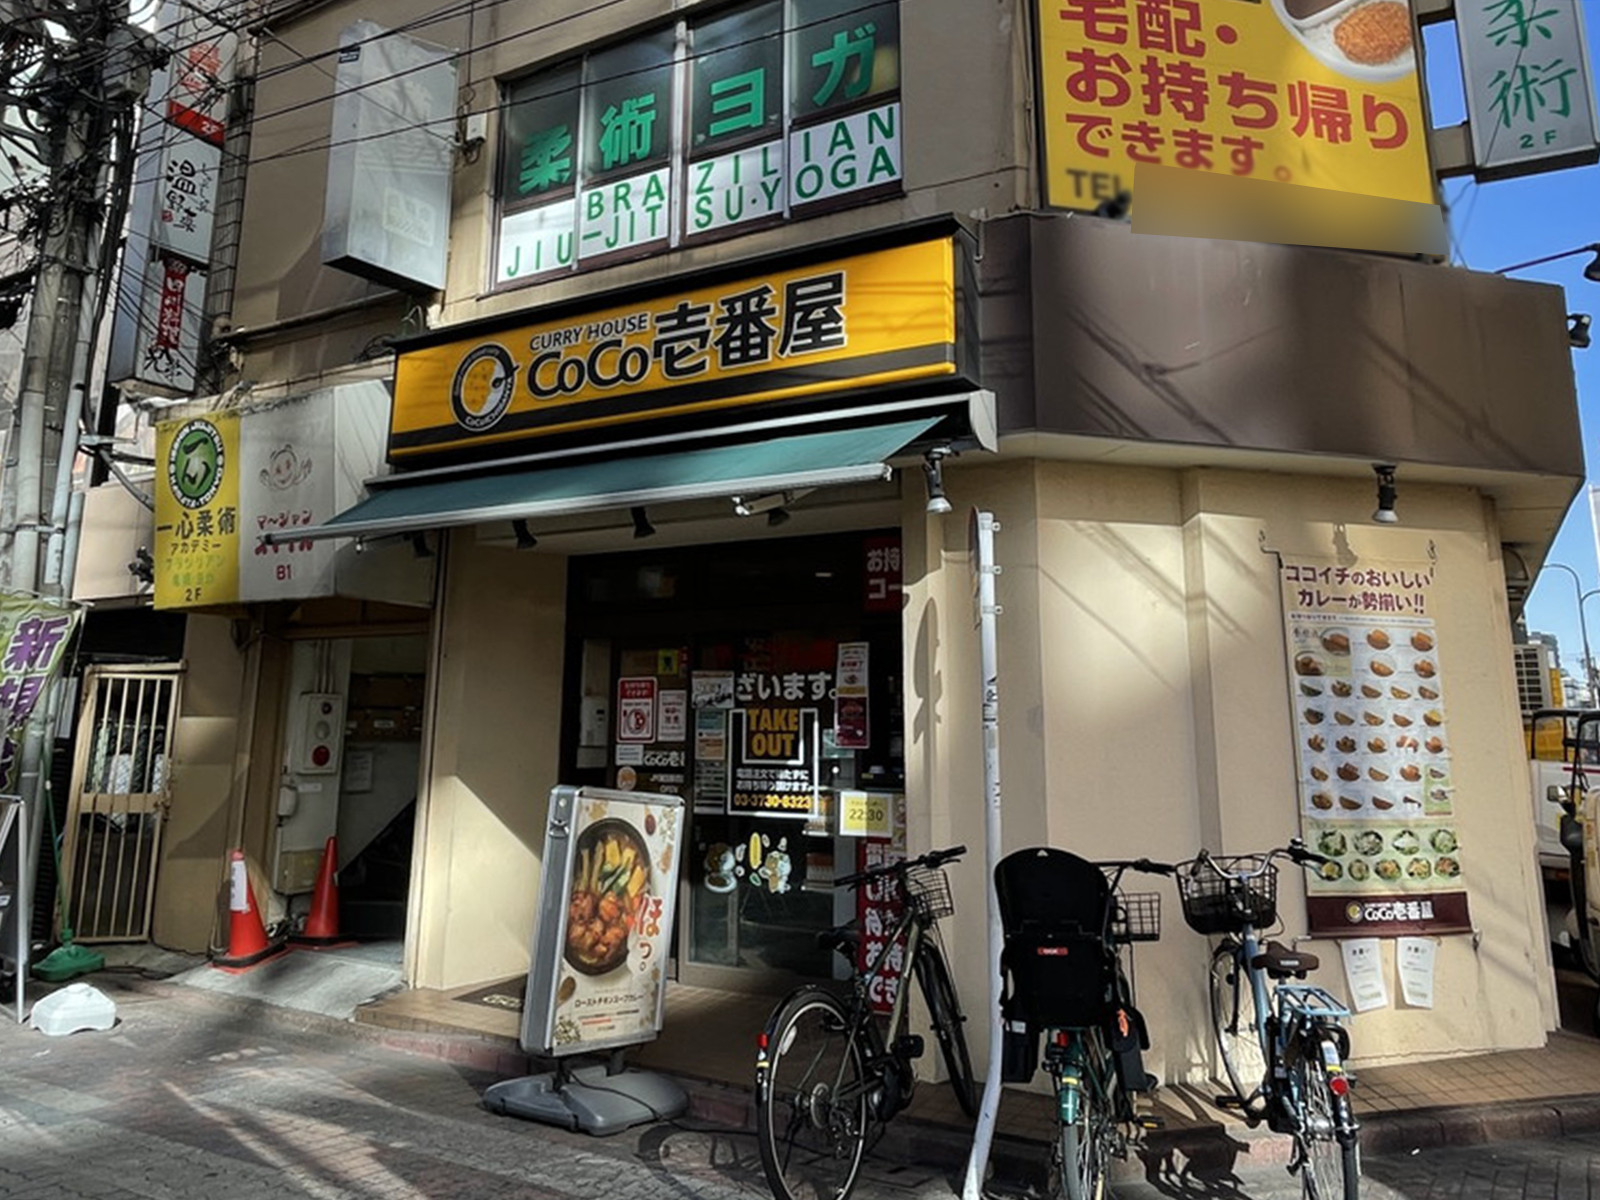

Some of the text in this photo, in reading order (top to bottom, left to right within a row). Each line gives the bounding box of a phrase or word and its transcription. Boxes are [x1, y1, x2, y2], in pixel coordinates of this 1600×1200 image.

[1482, 0, 1577, 129] 柔術
[1066, 47, 1409, 150] お持ち帰り
[1065, 113, 1292, 183] できます。
[1520, 131, 1557, 149] 2F
[587, 106, 895, 221] BRAZILIAN
[526, 271, 848, 401] CoCo壱番屋
[530, 313, 649, 352] CURRY HOUSE
[157, 506, 236, 540] 一心柔術
[276, 564, 292, 580] B1
[1286, 565, 1431, 589] ココイチのおいしい
[185, 588, 203, 602] 2F
[736, 672, 838, 701] ざいます。
[748, 708, 799, 732] TAKE
[752, 733, 796, 757] OUT
